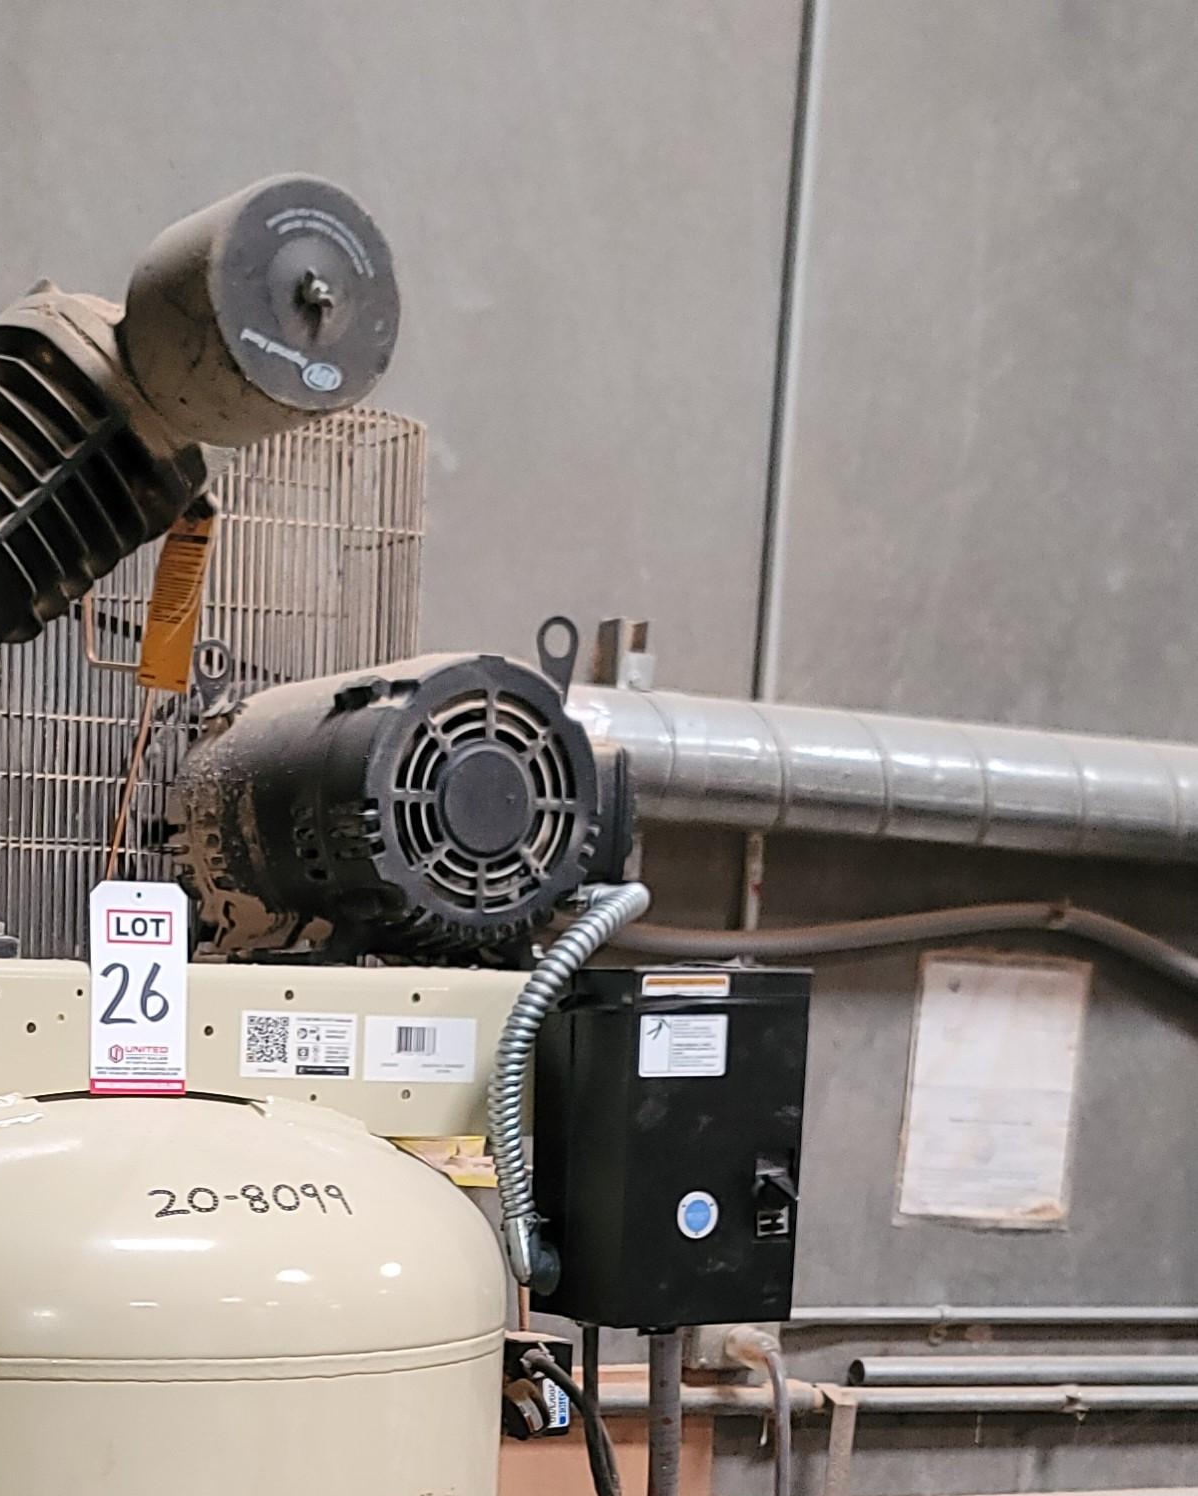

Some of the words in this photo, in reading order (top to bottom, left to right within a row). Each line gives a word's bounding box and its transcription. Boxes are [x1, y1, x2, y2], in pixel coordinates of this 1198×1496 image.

[115, 916, 166, 938] LOT
[99, 961, 170, 1026] 26
[125, 1046, 170, 1054] UNITED
[147, 1183, 353, 1218] 20-8099
